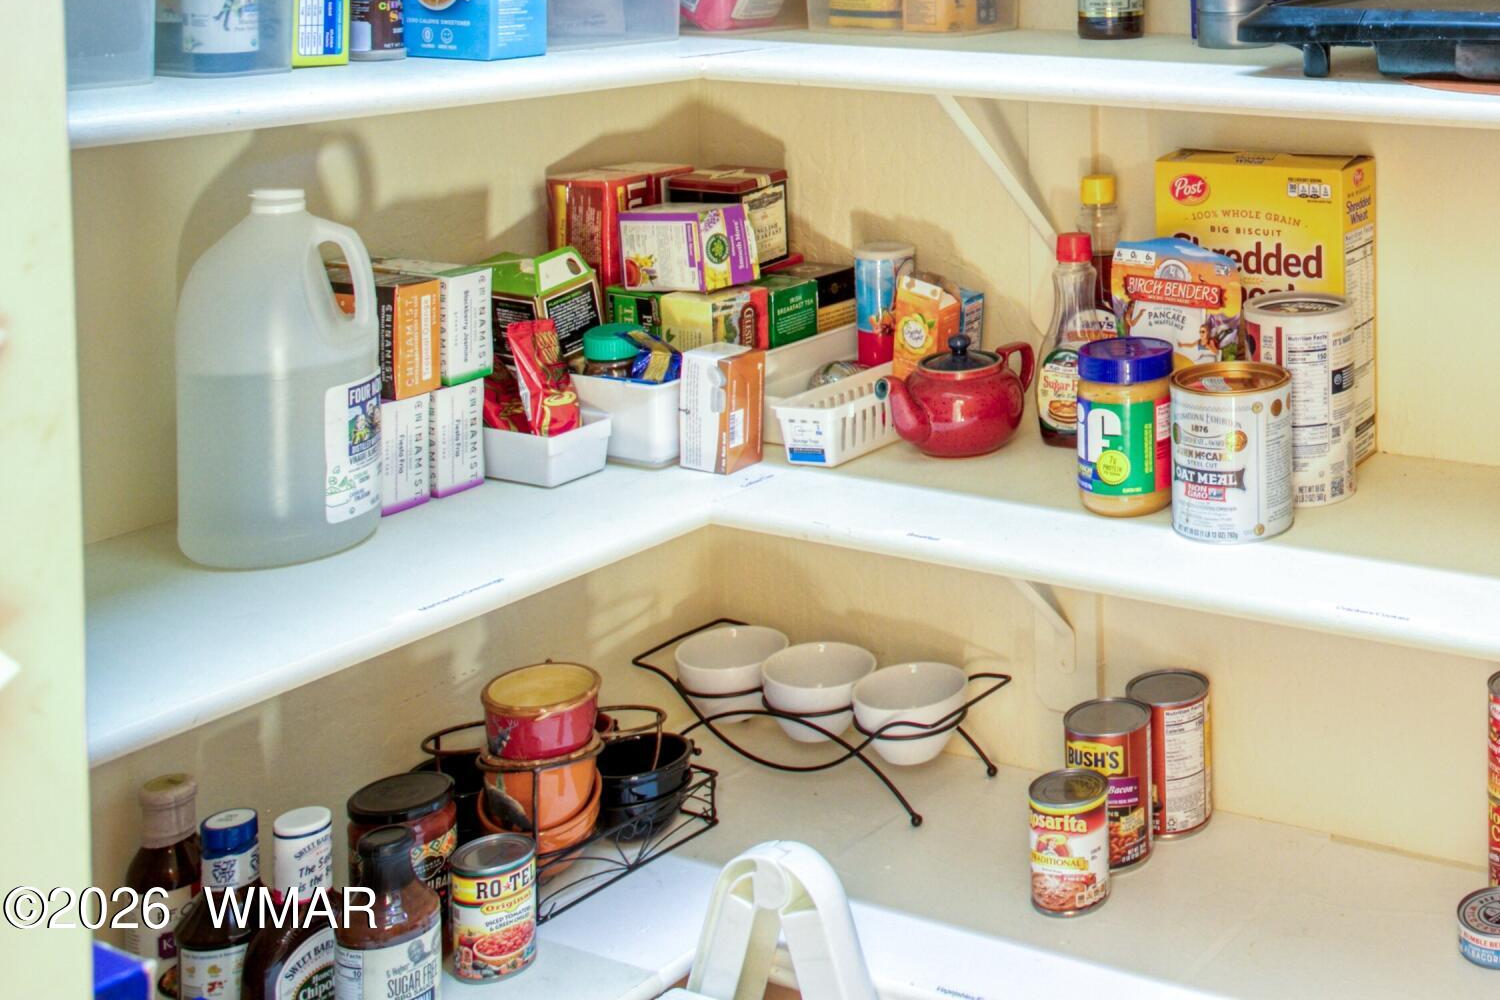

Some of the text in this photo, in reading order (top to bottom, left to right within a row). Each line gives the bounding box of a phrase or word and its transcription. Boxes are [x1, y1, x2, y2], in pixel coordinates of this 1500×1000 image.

[1174, 177, 1203, 197] Post
[1191, 209, 1301, 227] 100% WHOLE GRAIN
[1210, 225, 1282, 237] BIG BISCUIT
[1127, 276, 1163, 294] BIRCH
[1164, 280, 1220, 304] BENDERS
[1148, 311, 1187, 324] PANCAKE
[1043, 376, 1070, 390] Sugar
[1191, 424, 1209, 434] 1876
[1175, 467, 1238, 485] OAT MEAL
[1067, 746, 1120, 769] BUSH'S
[299, 864, 316, 878] The
[486, 889, 532, 912] Original
[387, 972, 421, 998] SUGAR
